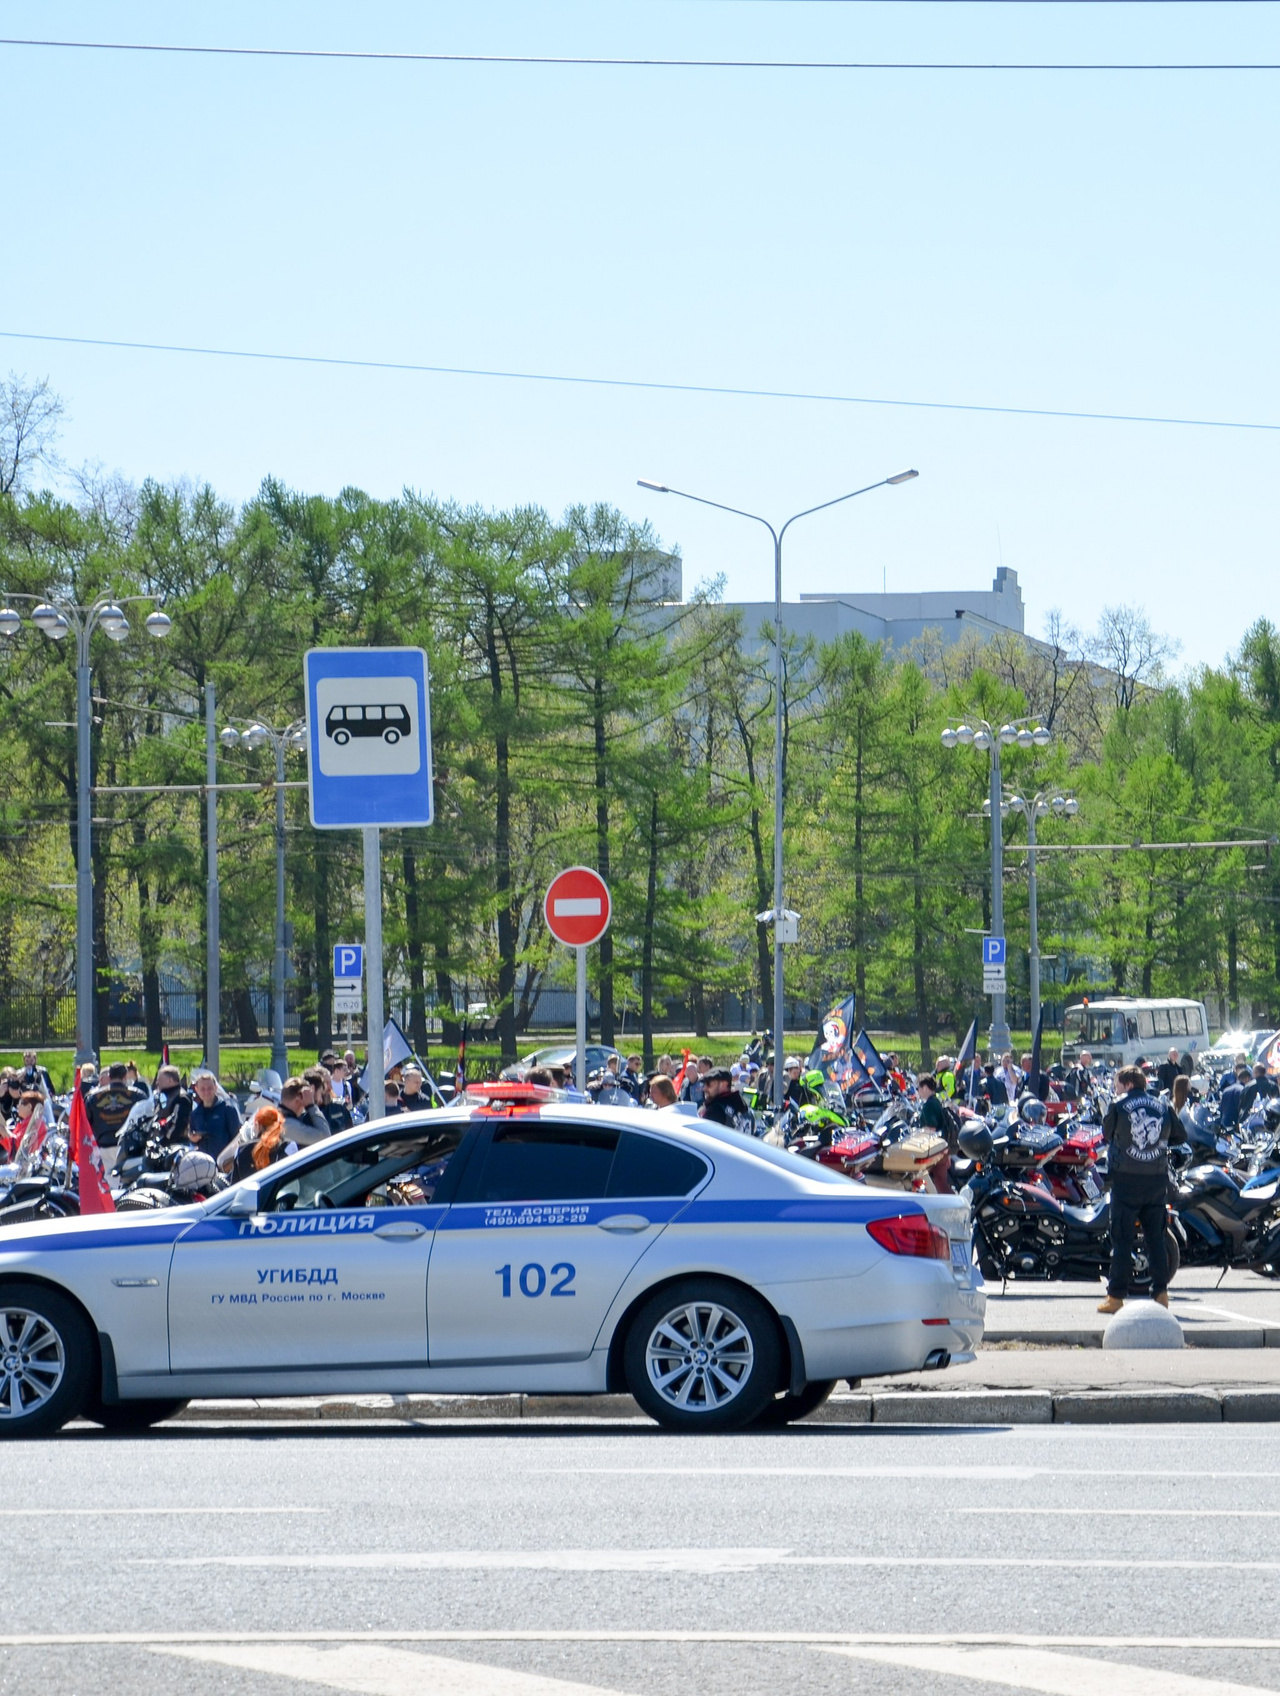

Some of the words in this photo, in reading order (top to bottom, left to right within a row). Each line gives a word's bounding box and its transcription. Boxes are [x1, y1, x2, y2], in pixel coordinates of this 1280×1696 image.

[989, 940, 1000, 961] P
[341, 949, 356, 974] P
[485, 1208, 516, 1217] ТЕЛ.
[521, 1206, 590, 1216] ДОВЕРИЯ
[239, 1214, 375, 1235] ПОЛИЦИЯ
[257, 1268, 338, 1285] УГИБДД
[495, 1262, 576, 1298] 102
[211, 1294, 225, 1304] ГУ
[229, 1293, 257, 1304] МВД
[262, 1293, 304, 1303] России
[309, 1294, 323, 1302] по
[341, 1291, 385, 1301] Москве
